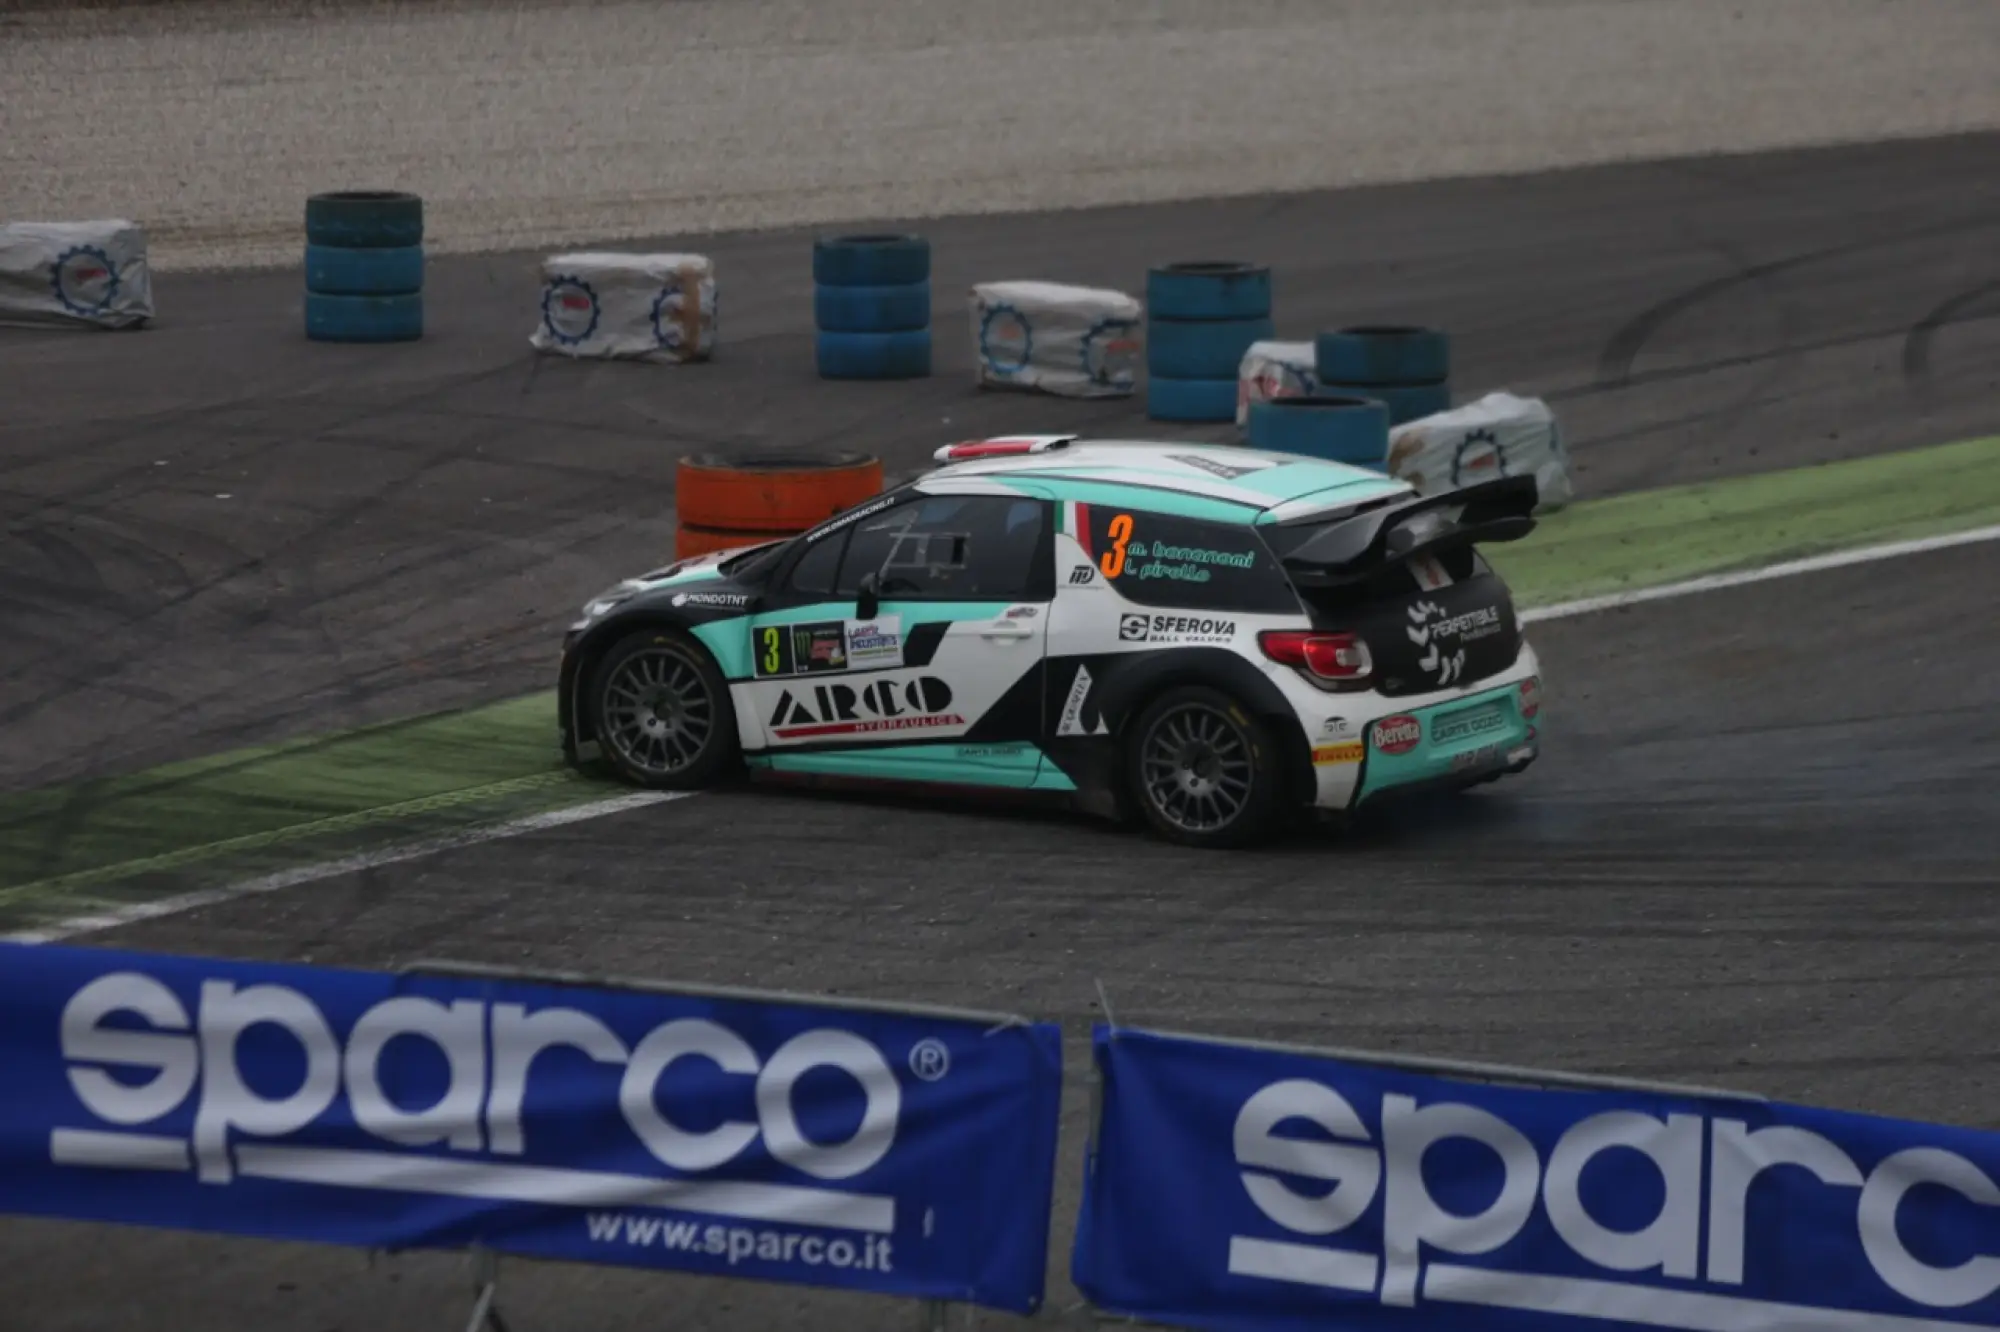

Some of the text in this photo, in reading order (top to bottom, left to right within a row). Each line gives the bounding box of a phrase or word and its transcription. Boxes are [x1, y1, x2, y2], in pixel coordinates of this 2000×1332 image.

[1100, 514, 1134, 580] 3
[763, 626, 781, 674] 3
[1152, 616, 1236, 637] SFEROVA
[1374, 721, 1420, 748] Beretta
[61, 972, 901, 1184] sparco
[586, 1212, 894, 1273] www.sparco.it
